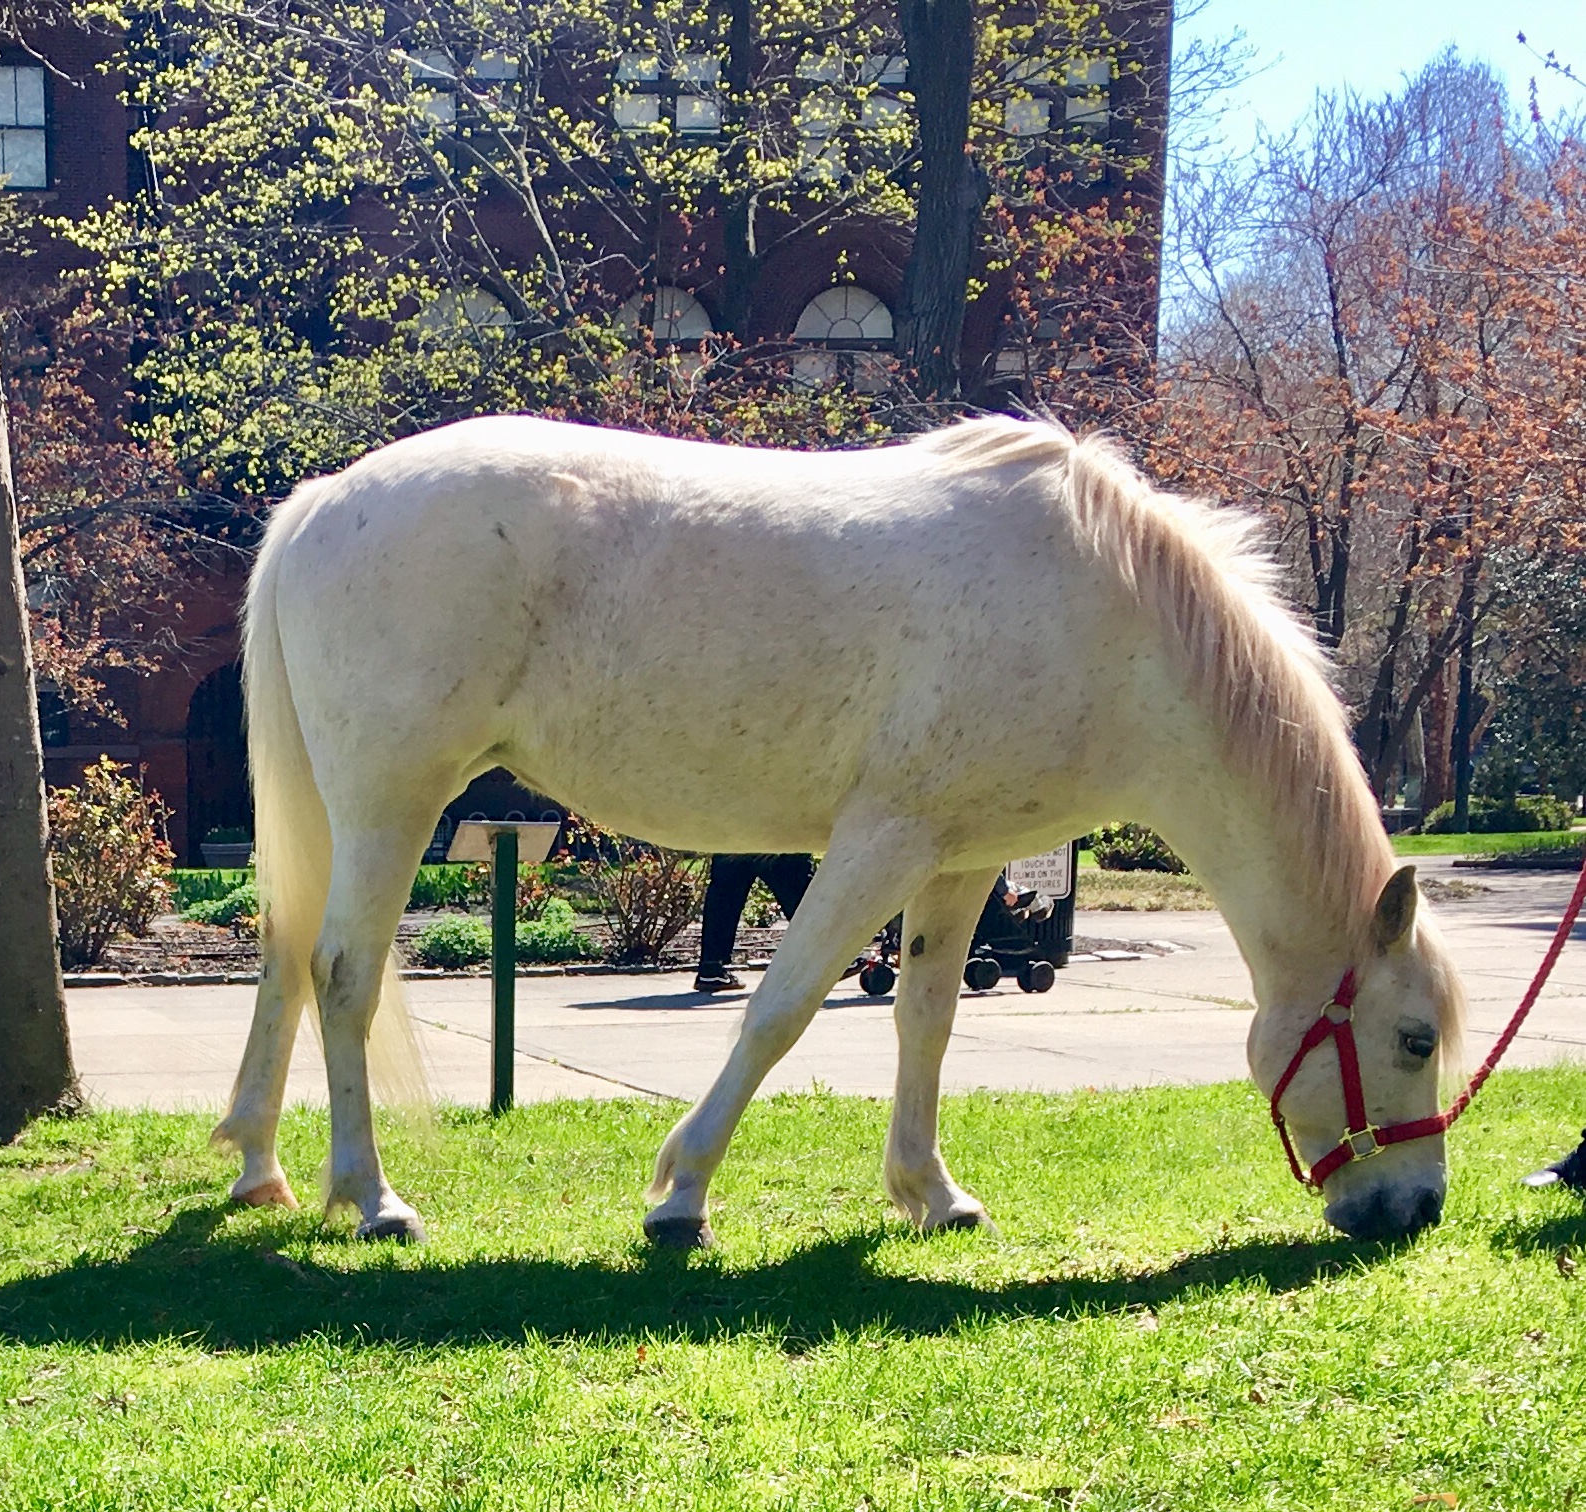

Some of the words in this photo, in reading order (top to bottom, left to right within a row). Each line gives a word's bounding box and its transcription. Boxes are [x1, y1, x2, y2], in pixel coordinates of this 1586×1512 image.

[1053, 848, 1066, 856] NOT
[1021, 860, 1044, 868] TOUCH
[1047, 858, 1056, 868] OR
[1013, 870, 1036, 880] CLIMB
[1038, 870, 1048, 878] ON
[1050, 868, 1063, 878] THE
